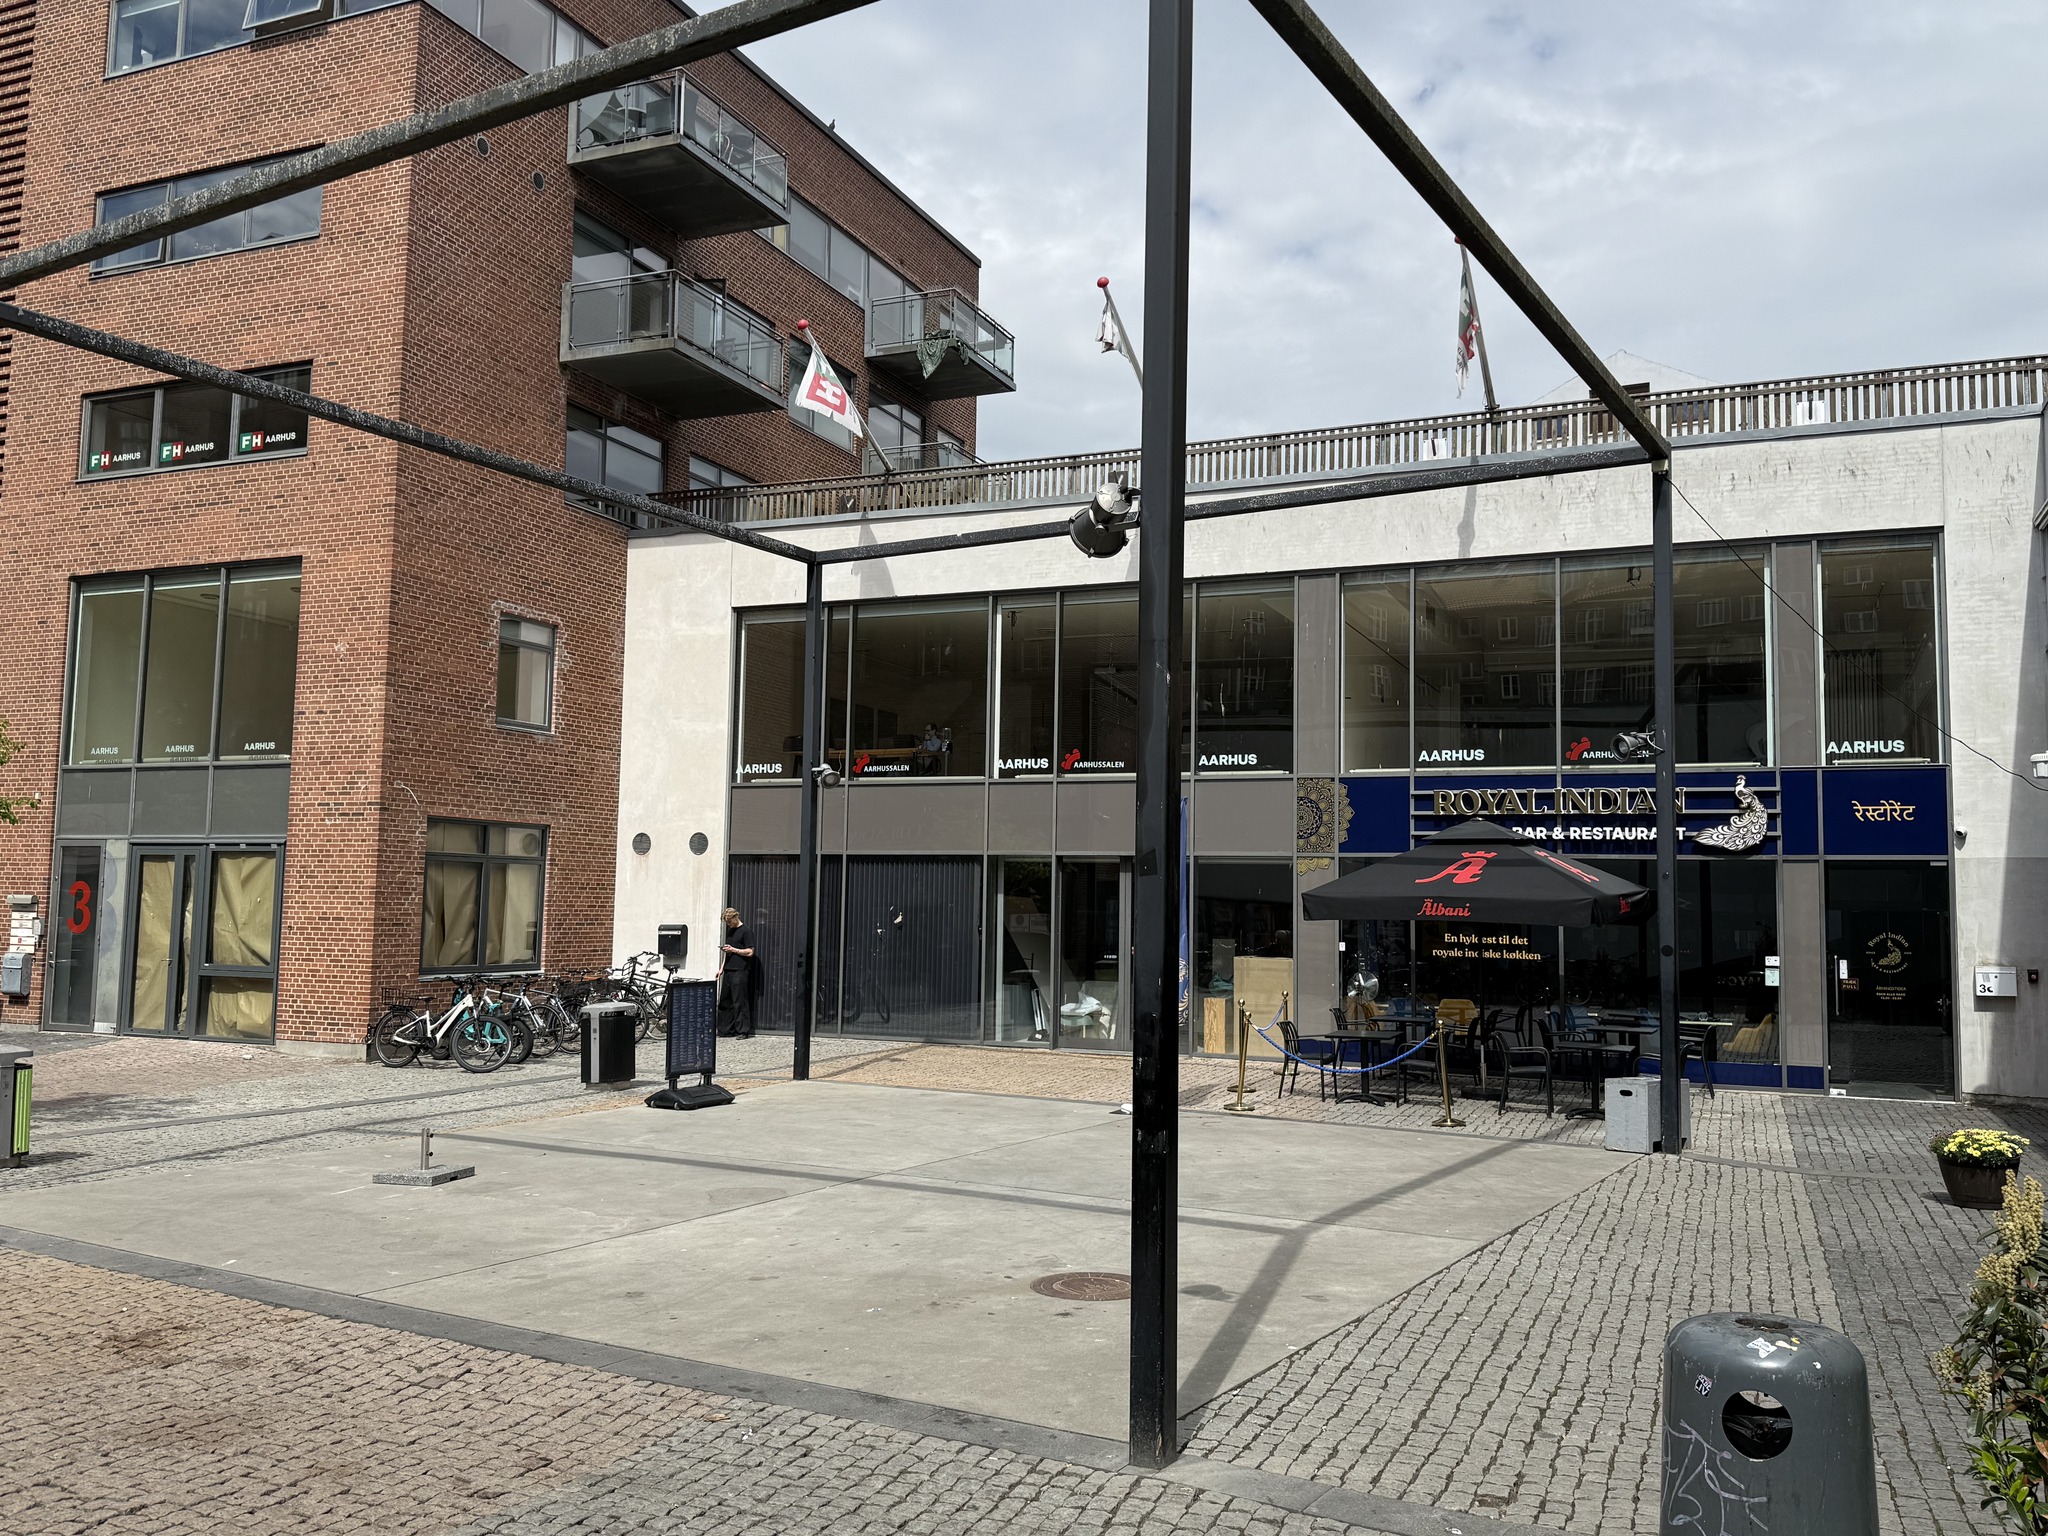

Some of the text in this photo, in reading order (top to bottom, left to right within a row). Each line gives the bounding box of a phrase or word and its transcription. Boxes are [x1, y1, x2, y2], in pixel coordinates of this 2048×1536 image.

[241, 432, 296, 449] FH AARHUS
[162, 442, 214, 460] FH AARHUS
[91, 452, 141, 467] FH AARHUS
[90, 746, 119, 755] AARHUS
[165, 744, 195, 753] AARHUS
[244, 742, 276, 751] AARHUS
[1826, 740, 1905, 754] AARHUS
[1198, 753, 1258, 766] AARHUS
[1418, 749, 1485, 762] AARHUS
[735, 763, 783, 774] AARHUS
[863, 764, 910, 773] AARHUSSALEN
[996, 758, 1049, 769] AARHUS
[1073, 761, 1125, 769] AARHUSSALEN
[1432, 787, 1548, 816] ROYAL
[1852, 800, 1916, 821] रेस्टोरेंट
[1552, 827, 1565, 840] &
[1569, 826, 1687, 841] RESTAURAT
[67, 881, 91, 934] 3
[1417, 899, 1471, 916] Albani
[1444, 933, 1458, 943] En
[1499, 935, 1510, 945] til
[1511, 935, 1528, 945] det
[1868, 932, 1909, 947] Royal Indian
[1432, 948, 1463, 959] royale
[1503, 950, 1542, 961] køkken
